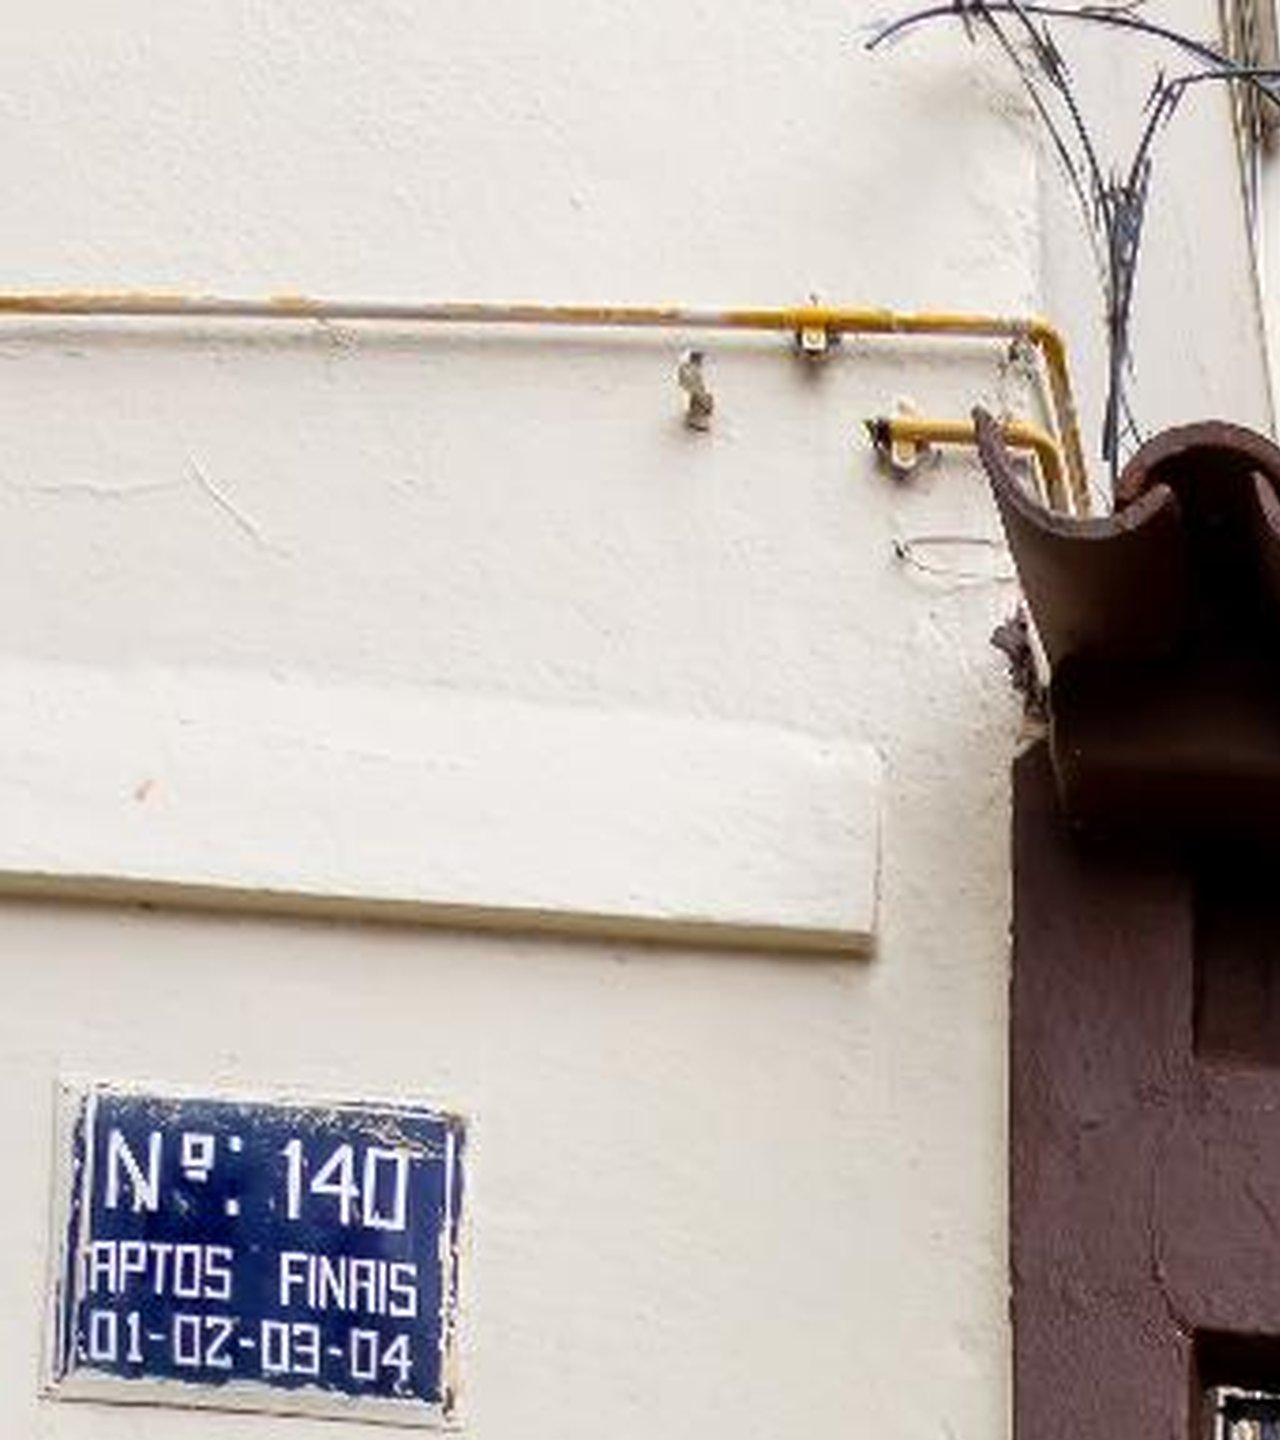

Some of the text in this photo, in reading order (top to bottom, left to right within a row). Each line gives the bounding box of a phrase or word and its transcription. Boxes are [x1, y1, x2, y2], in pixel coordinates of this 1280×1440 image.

[282, 1137, 409, 1231] 140
[88, 1240, 418, 1319] APTOS FINAIS
[88, 1310, 414, 1382] 01-02-03-04
